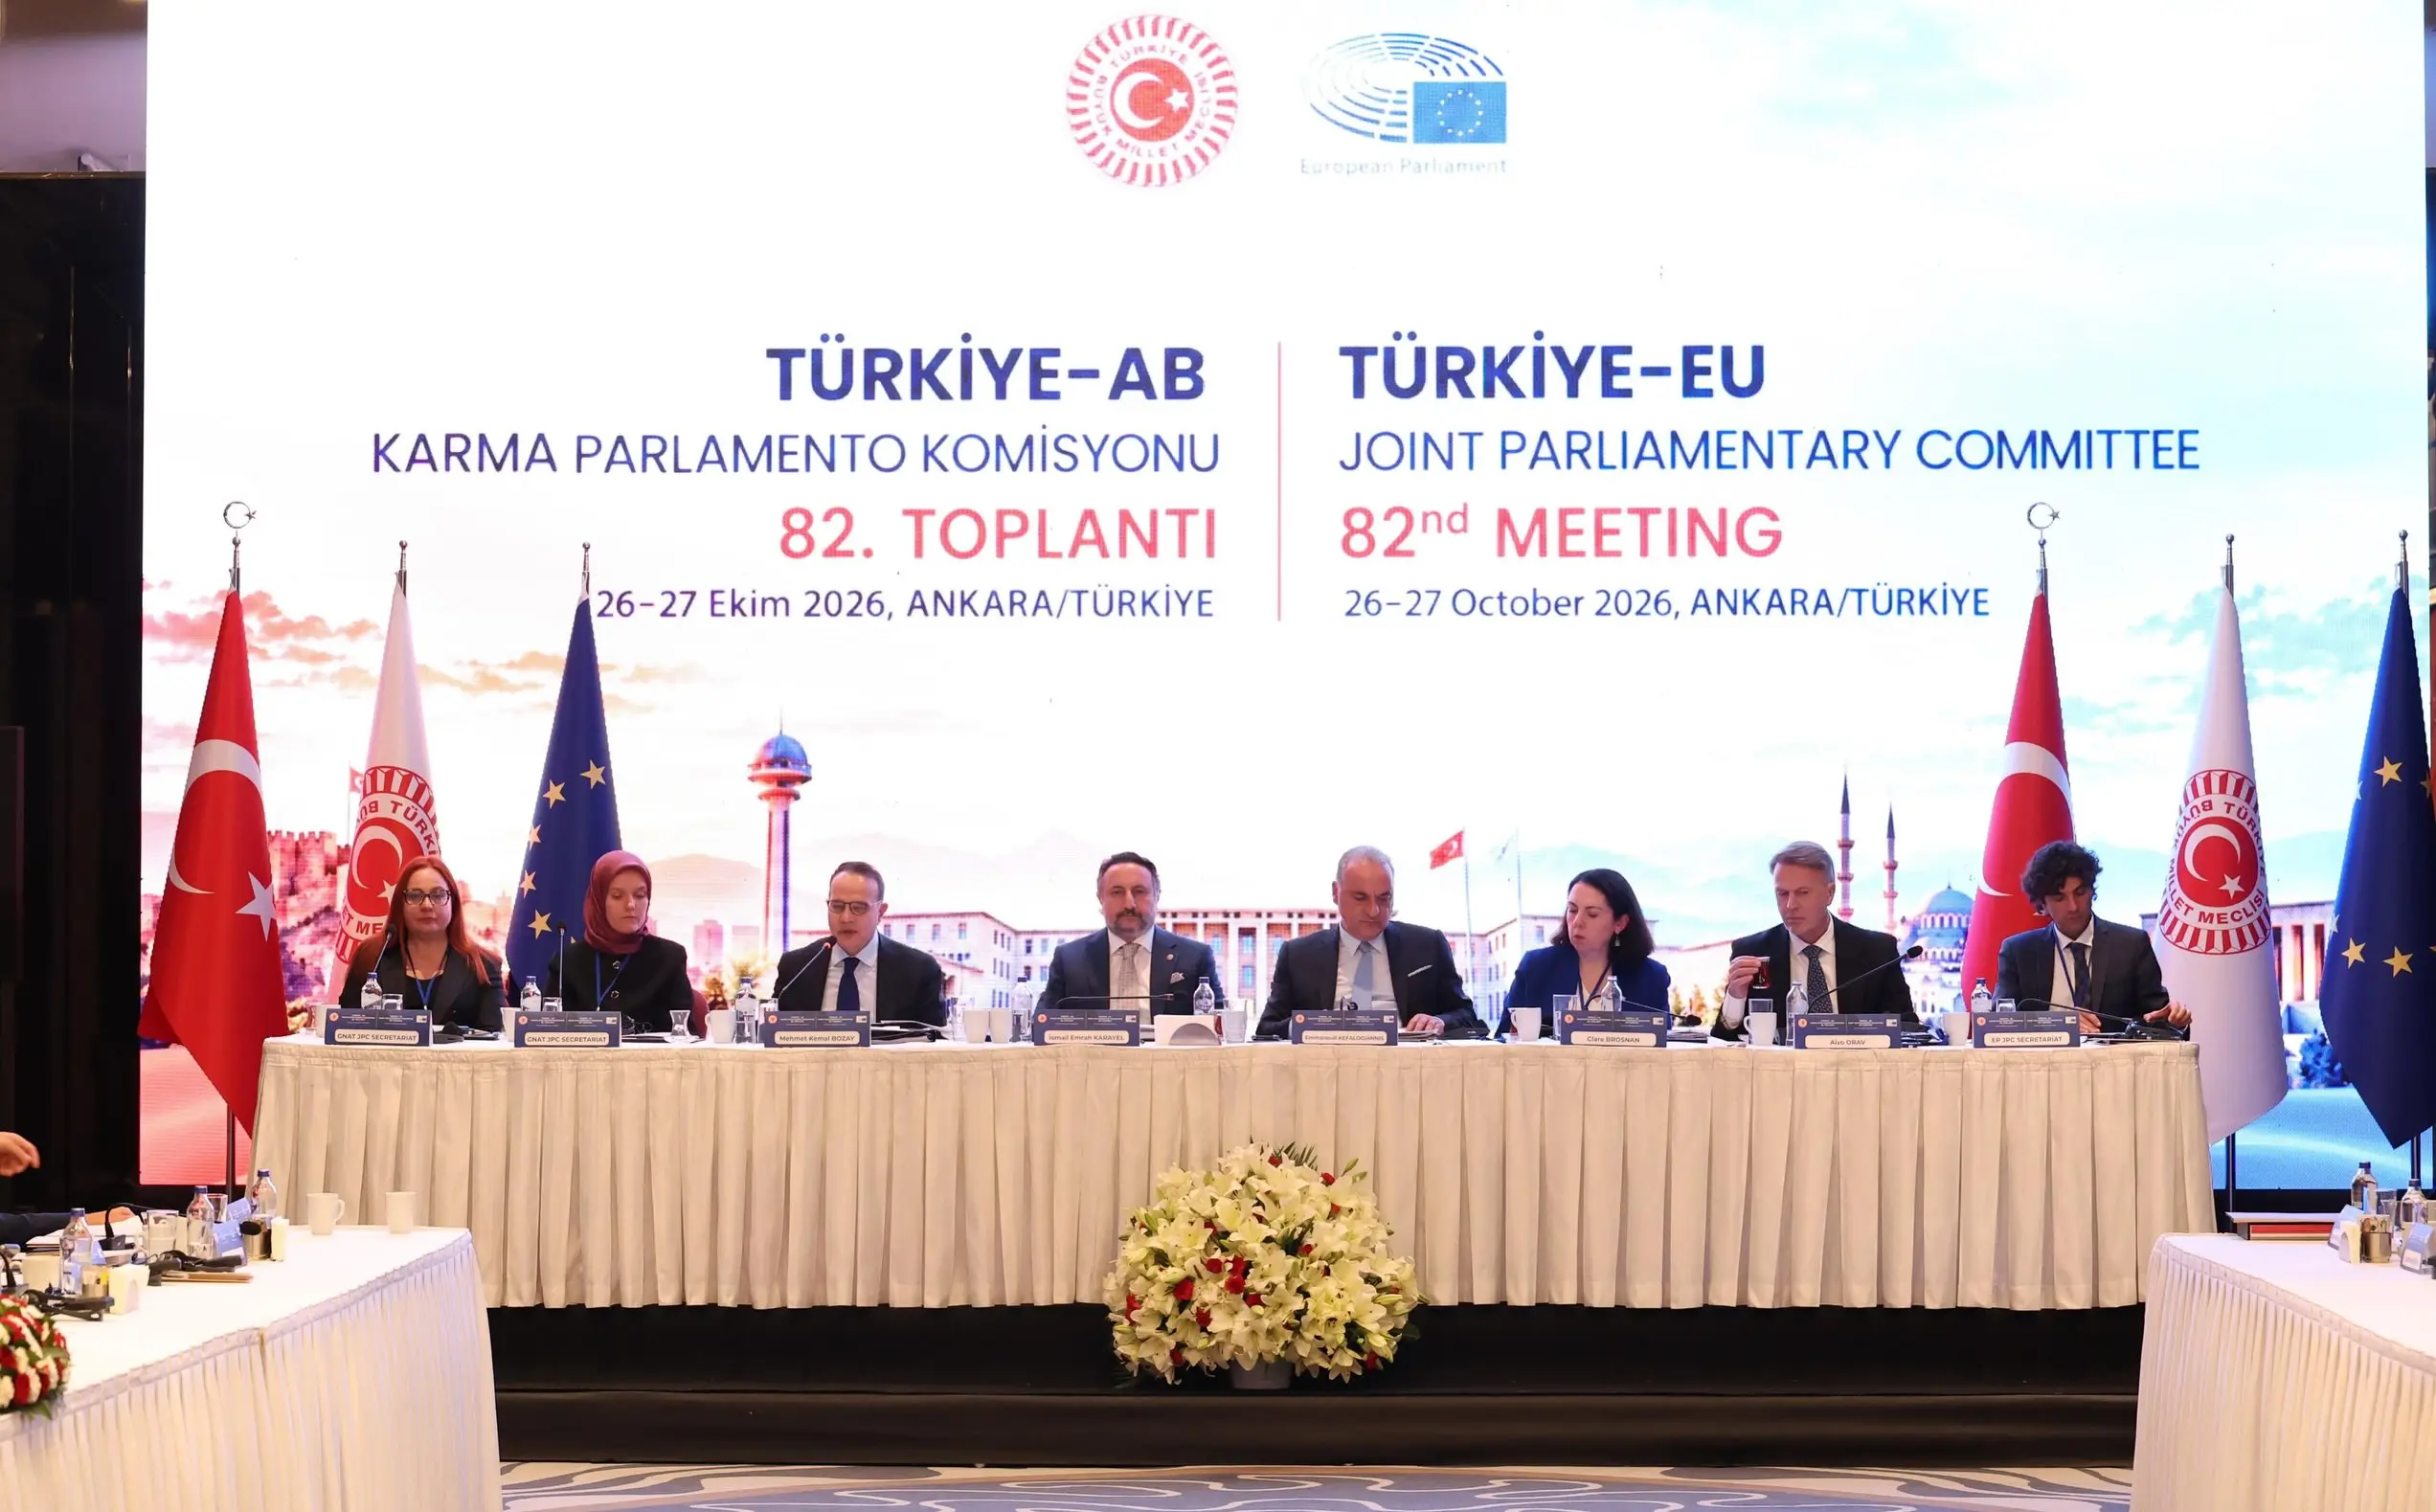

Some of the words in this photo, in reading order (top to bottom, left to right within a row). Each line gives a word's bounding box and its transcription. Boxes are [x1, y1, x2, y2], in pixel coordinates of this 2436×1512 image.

[1300, 158, 1393, 176] European
[1400, 157, 1506, 174] Parliament
[767, 333, 1204, 400] TÜRKİYE-AB
[1340, 330, 1764, 398] TÜRKİYE-EU
[374, 434, 556, 472] KARMA
[576, 435, 905, 473] PARLAMENTO
[924, 425, 1218, 472] KOMİSYONU
[1339, 432, 1483, 471] JOINT
[1500, 429, 1901, 470] PARLIAMENTARY
[1916, 429, 2199, 470] COMMITTEE
[781, 508, 872, 559] 82.
[903, 508, 1214, 559] TOPLANTI
[1342, 503, 1467, 557] 82nd
[1498, 508, 1782, 557] MEETING
[598, 591, 696, 617] 26-27
[710, 589, 789, 617] Ekim
[804, 591, 891, 620] 2026,
[908, 584, 1212, 617] ANKARA/TÜRKİYE
[1346, 590, 1440, 616] 26-27
[1453, 589, 1583, 616] October
[1596, 590, 1679, 619] 2026,
[1691, 582, 1989, 617] ANKARA/TÜRKİYE
